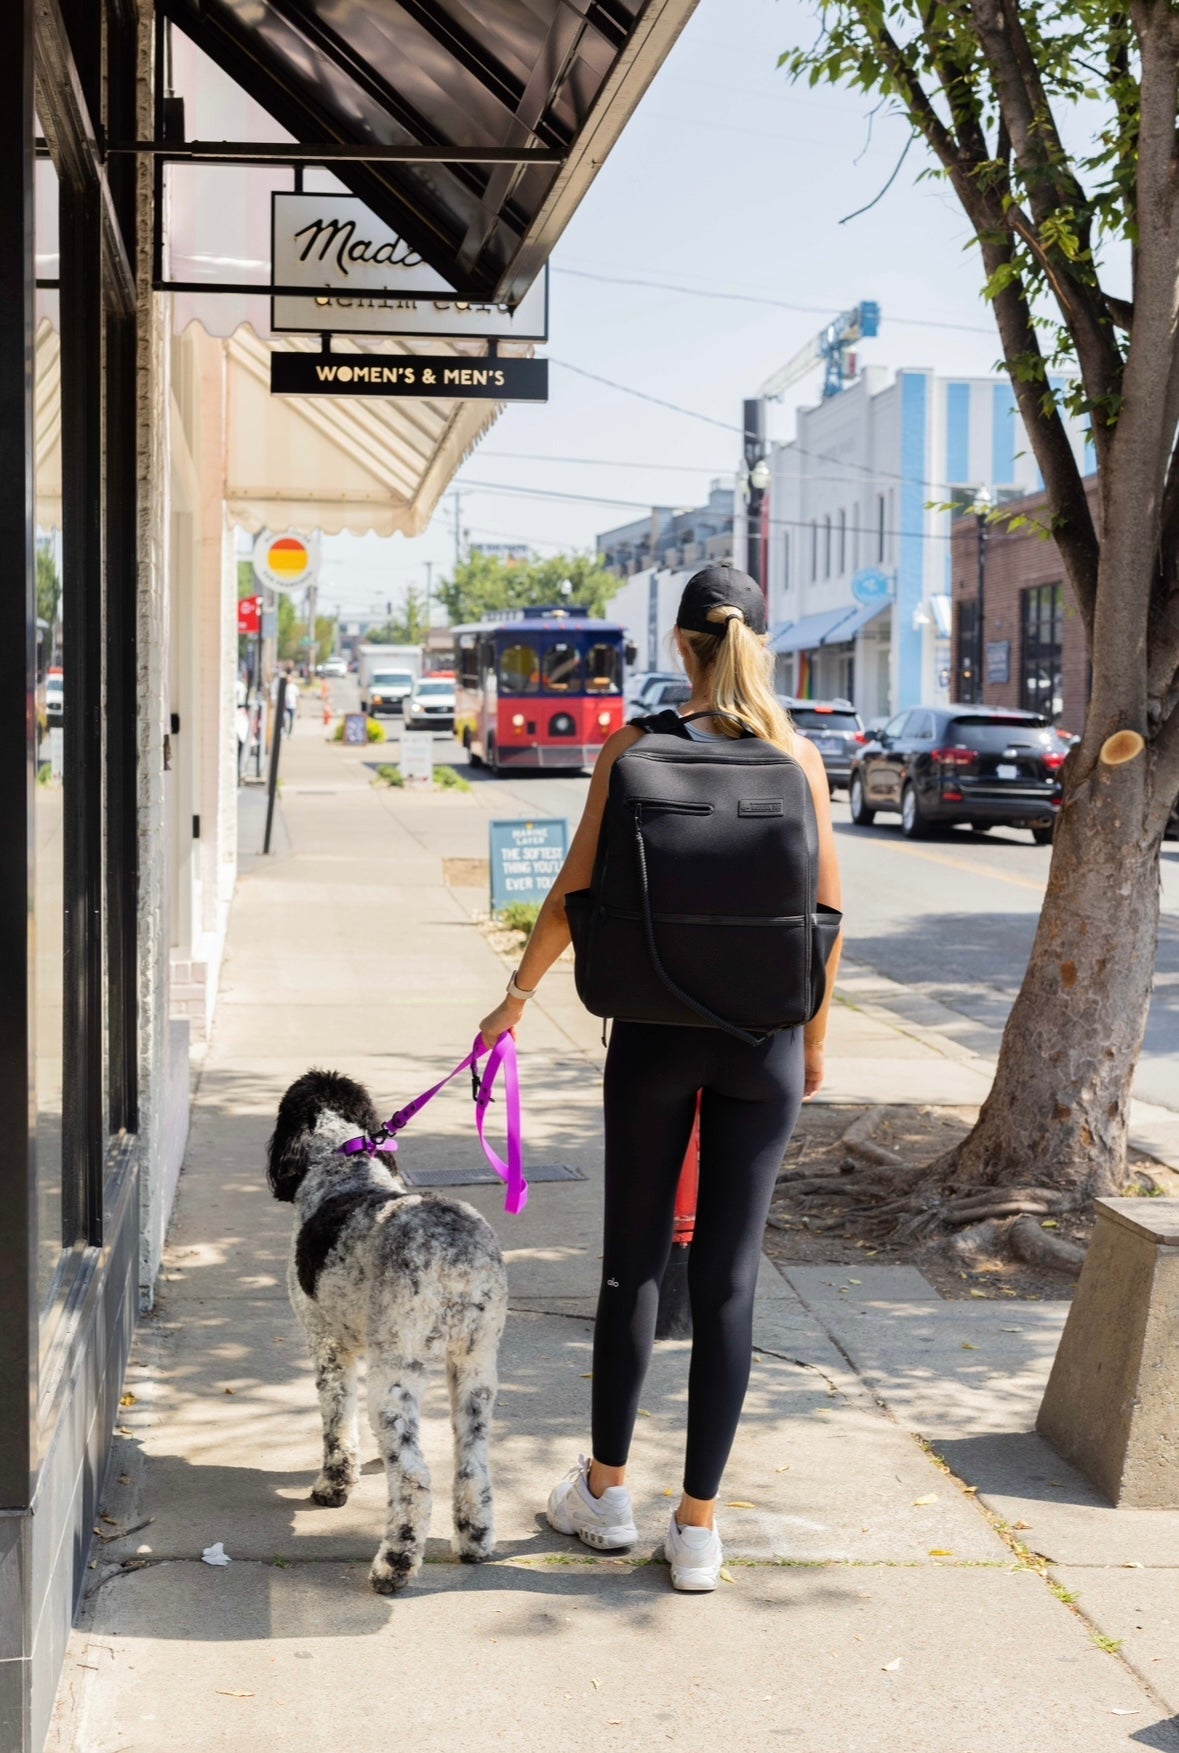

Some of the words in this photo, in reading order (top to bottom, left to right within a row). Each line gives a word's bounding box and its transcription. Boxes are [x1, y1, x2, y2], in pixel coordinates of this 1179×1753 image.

[315, 365, 415, 384] WOMEN'S
[421, 368, 436, 385] &
[443, 368, 505, 387] MEN'S
[501, 848, 521, 861] THE
[502, 860, 532, 875] THING
[505, 876, 533, 891] EVER
